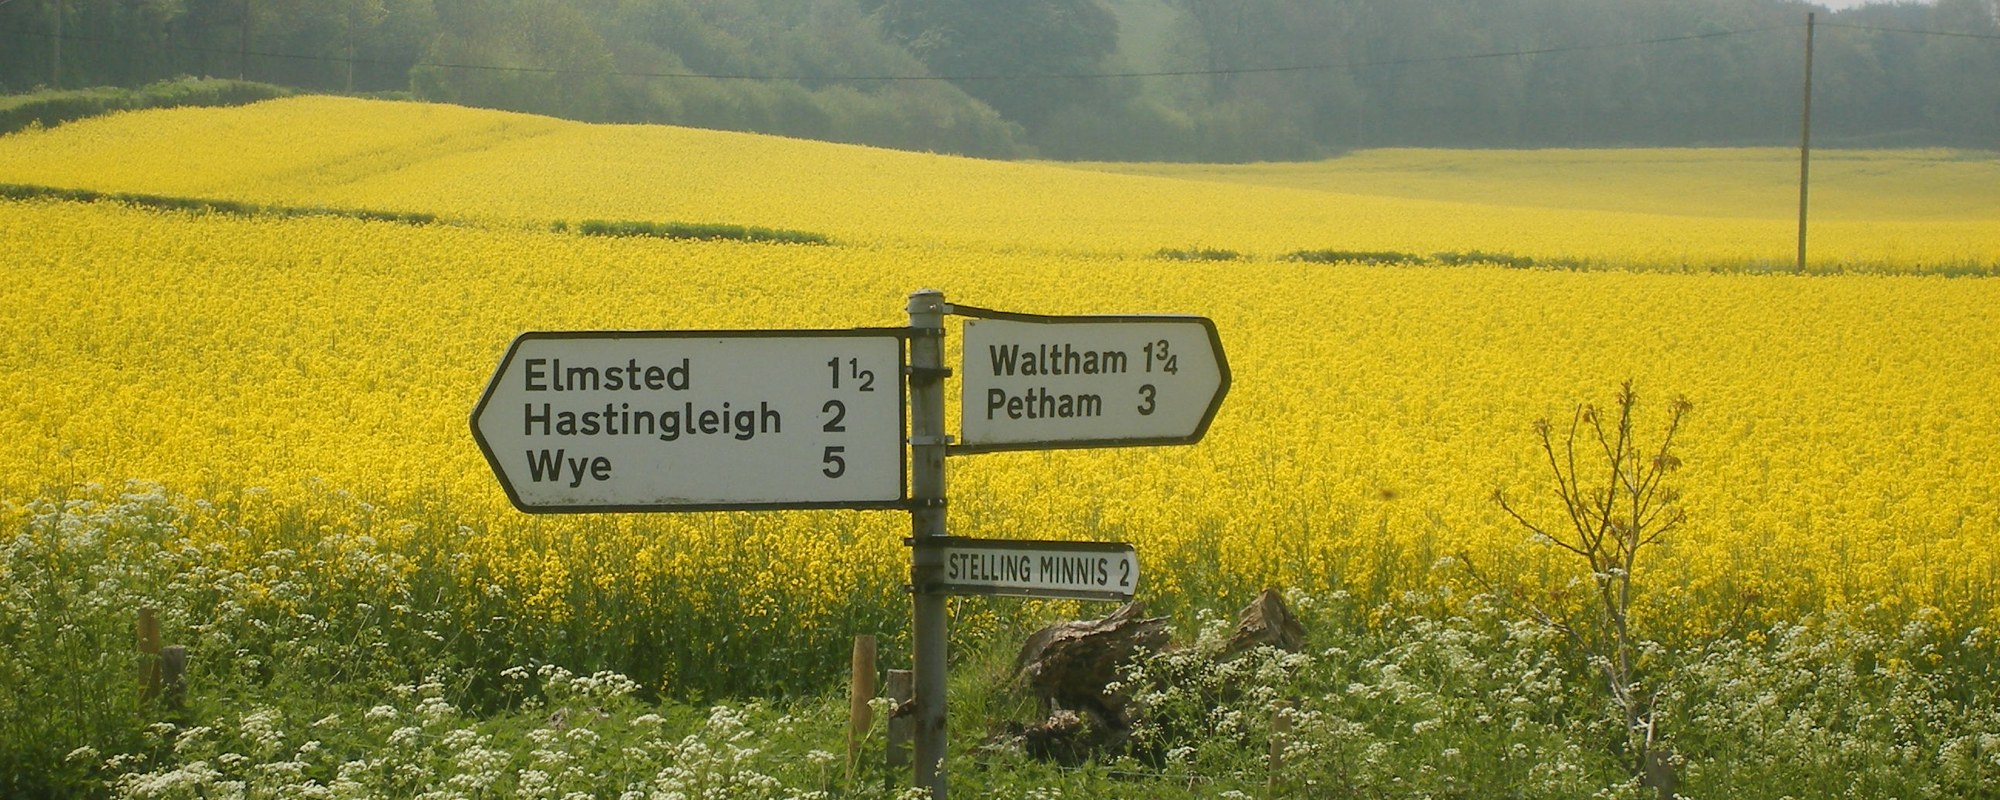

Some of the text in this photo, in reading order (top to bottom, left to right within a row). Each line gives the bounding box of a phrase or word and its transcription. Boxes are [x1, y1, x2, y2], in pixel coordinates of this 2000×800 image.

[524, 358, 690, 392] Elmsted
[989, 344, 1128, 376] Waltham
[987, 384, 1157, 420] Petham 3
[524, 400, 847, 441] Hastingleigh 2
[526, 446, 846, 488] Wye 5
[949, 553, 1130, 587] STELLING MINNIS 2
